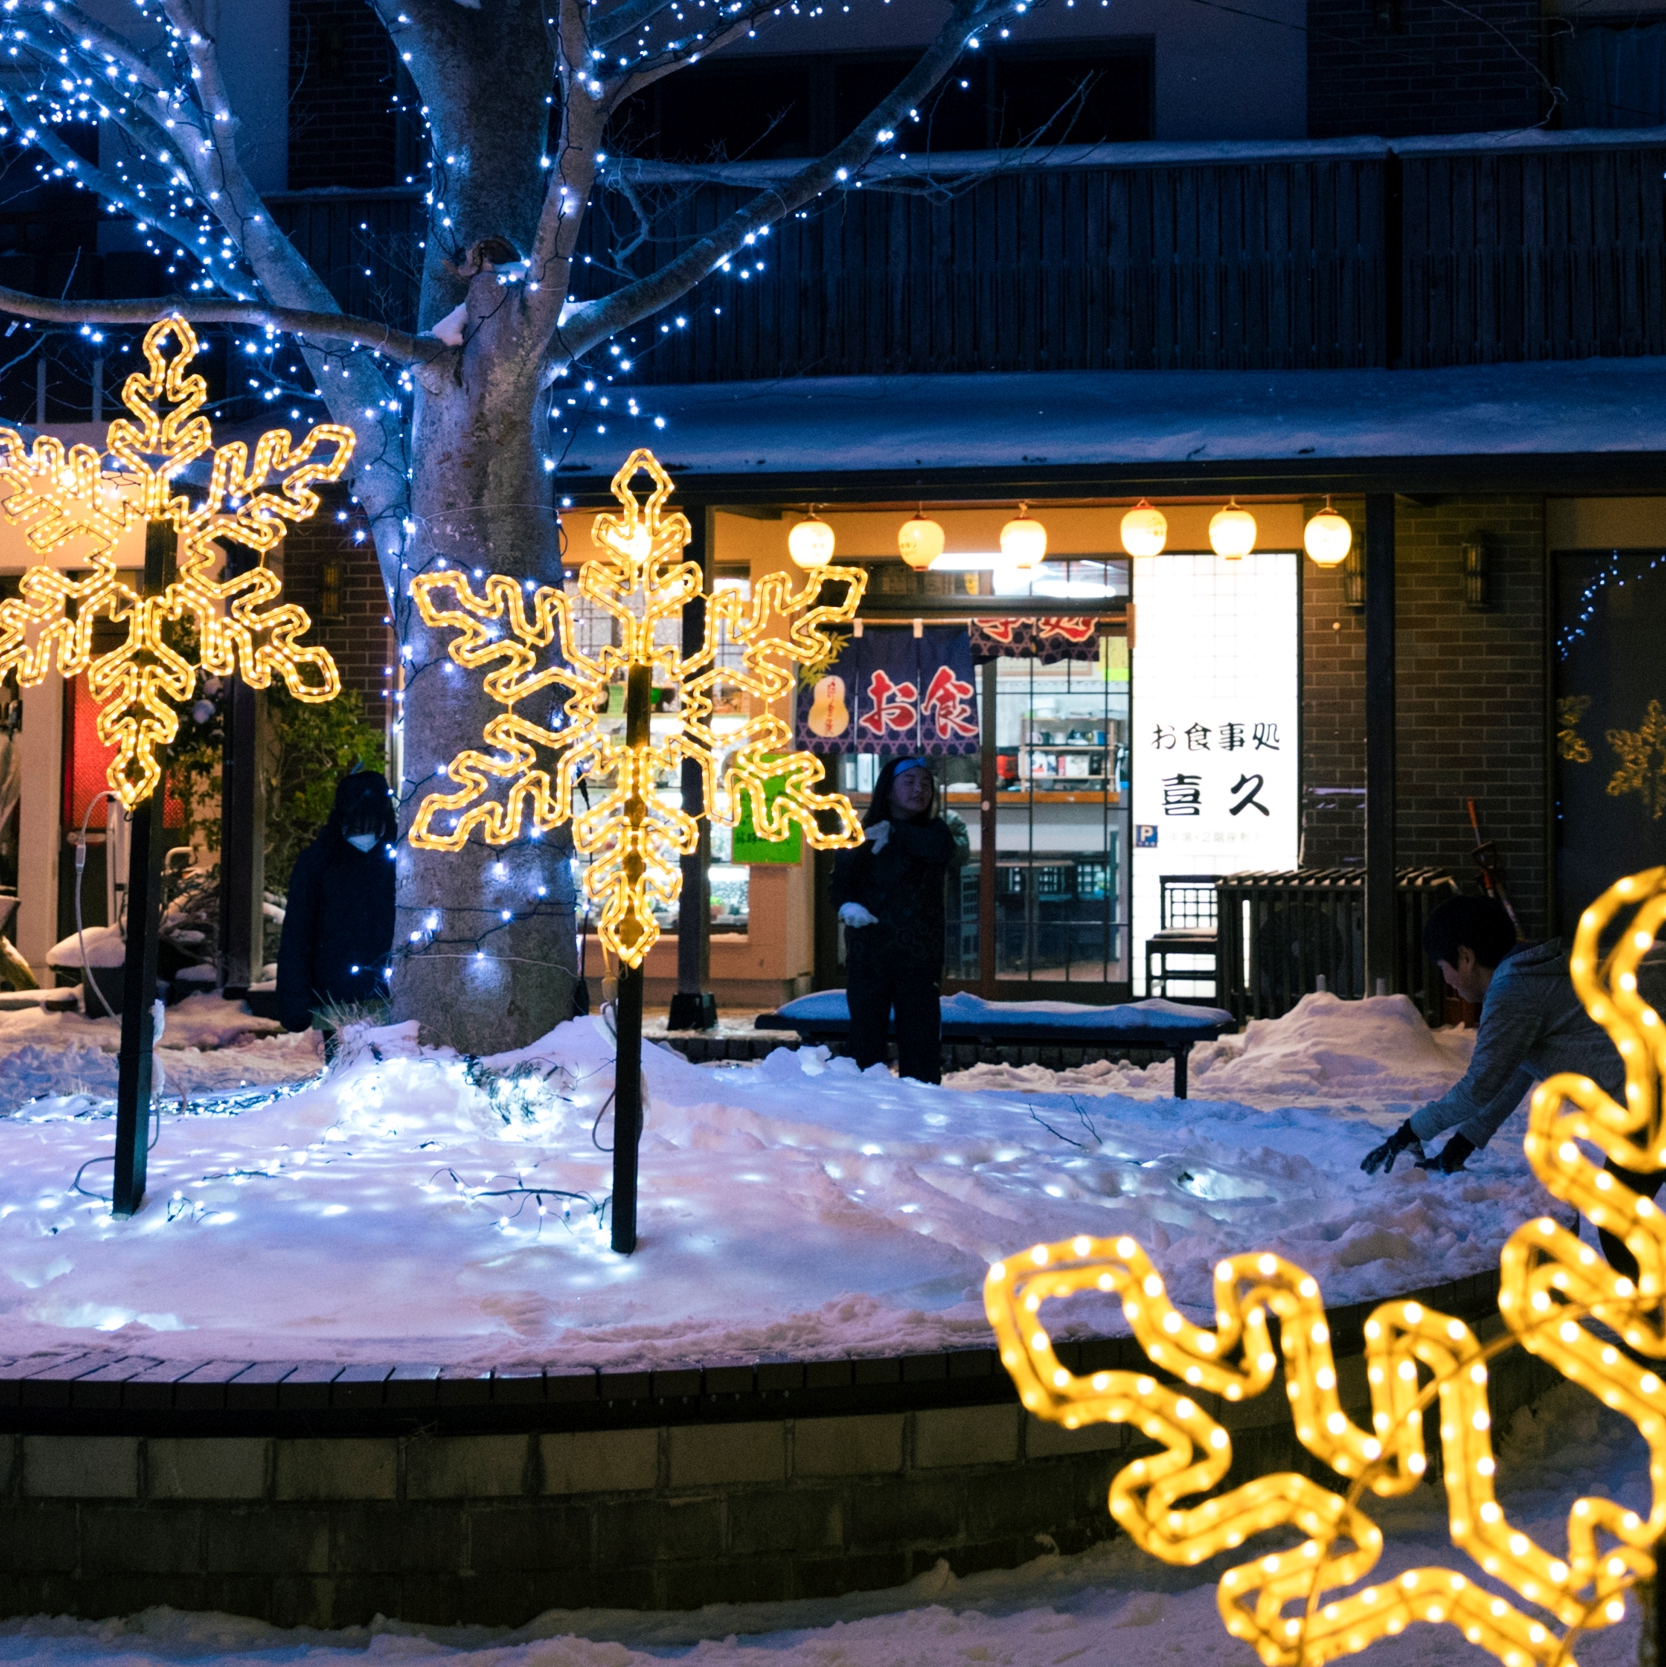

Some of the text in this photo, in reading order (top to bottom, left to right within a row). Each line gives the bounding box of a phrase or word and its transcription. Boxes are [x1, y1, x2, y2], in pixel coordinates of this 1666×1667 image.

[1151, 722, 1280, 751] お食事処
[1161, 773, 1270, 816] 喜久
[1141, 826, 1154, 842] P
